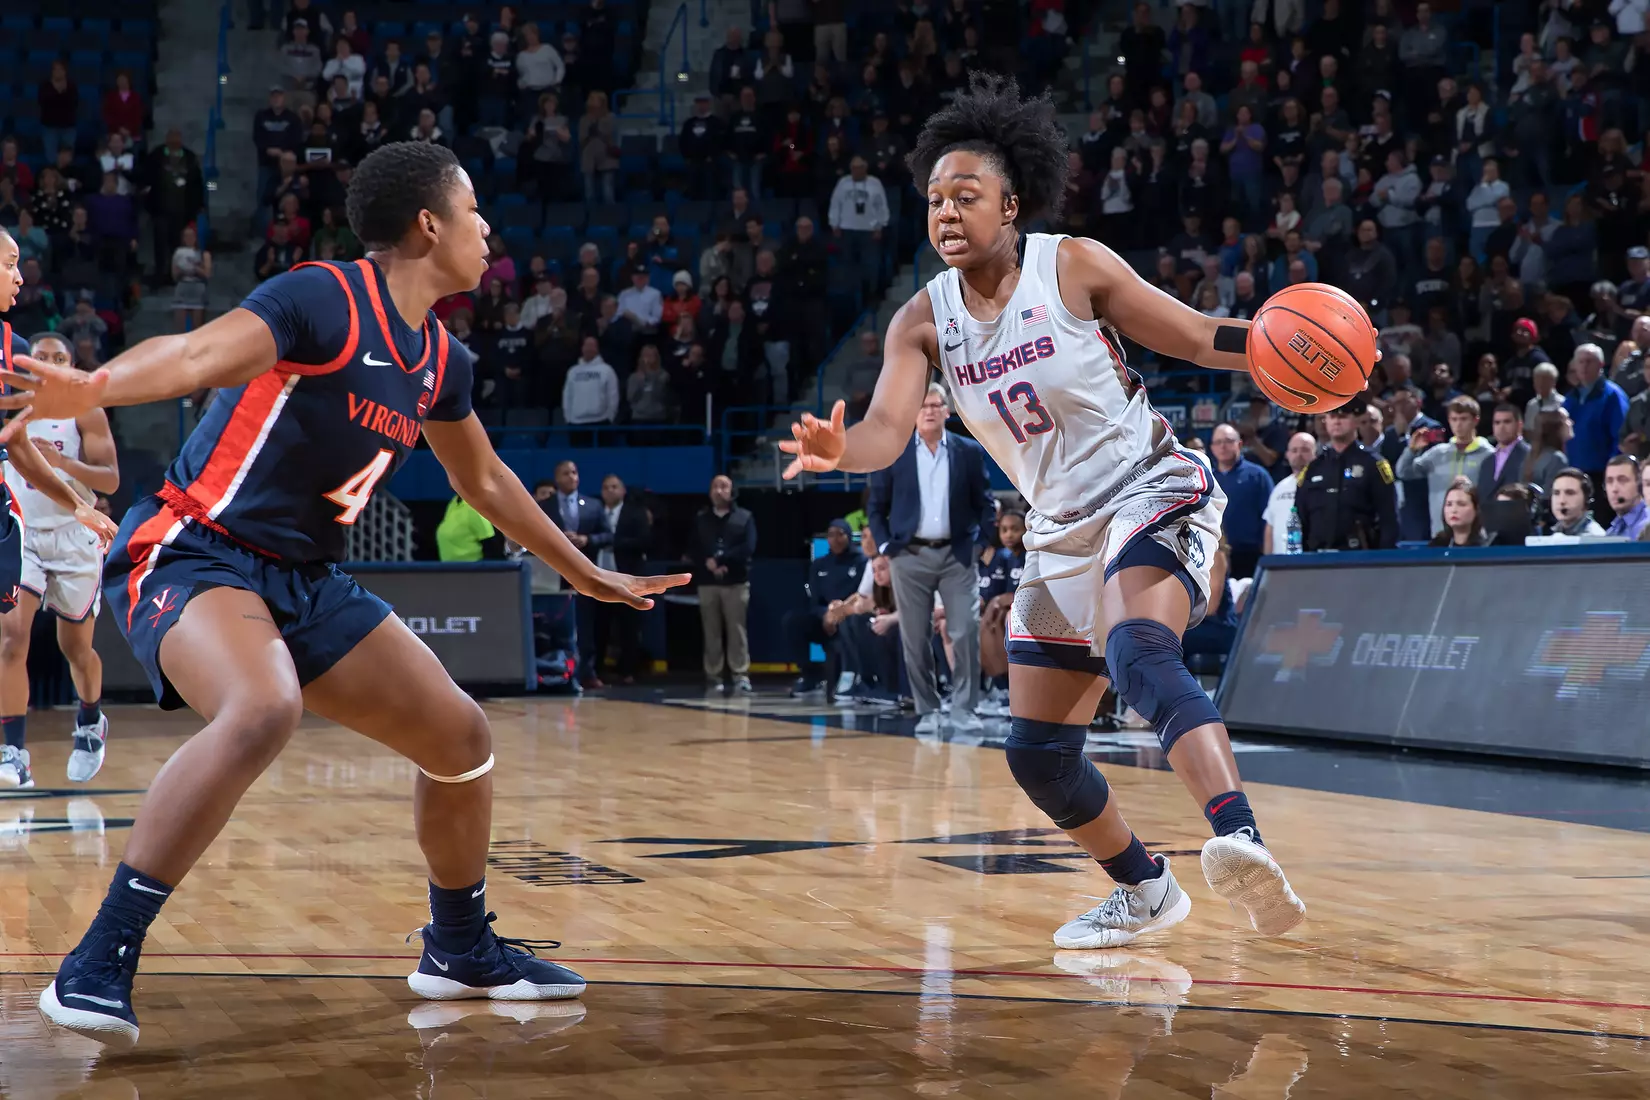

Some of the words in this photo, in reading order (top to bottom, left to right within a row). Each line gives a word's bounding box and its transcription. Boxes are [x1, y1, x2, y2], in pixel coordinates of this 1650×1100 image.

[954, 335, 1056, 387] HUSKIES
[1287, 332, 1342, 382] ELITE
[1298, 328, 1346, 368] CHAMPIONSHIP
[987, 381, 1055, 444] 13
[321, 447, 396, 525] 4
[400, 616, 482, 634] OLET
[1352, 633, 1480, 670] CHEVROLET
